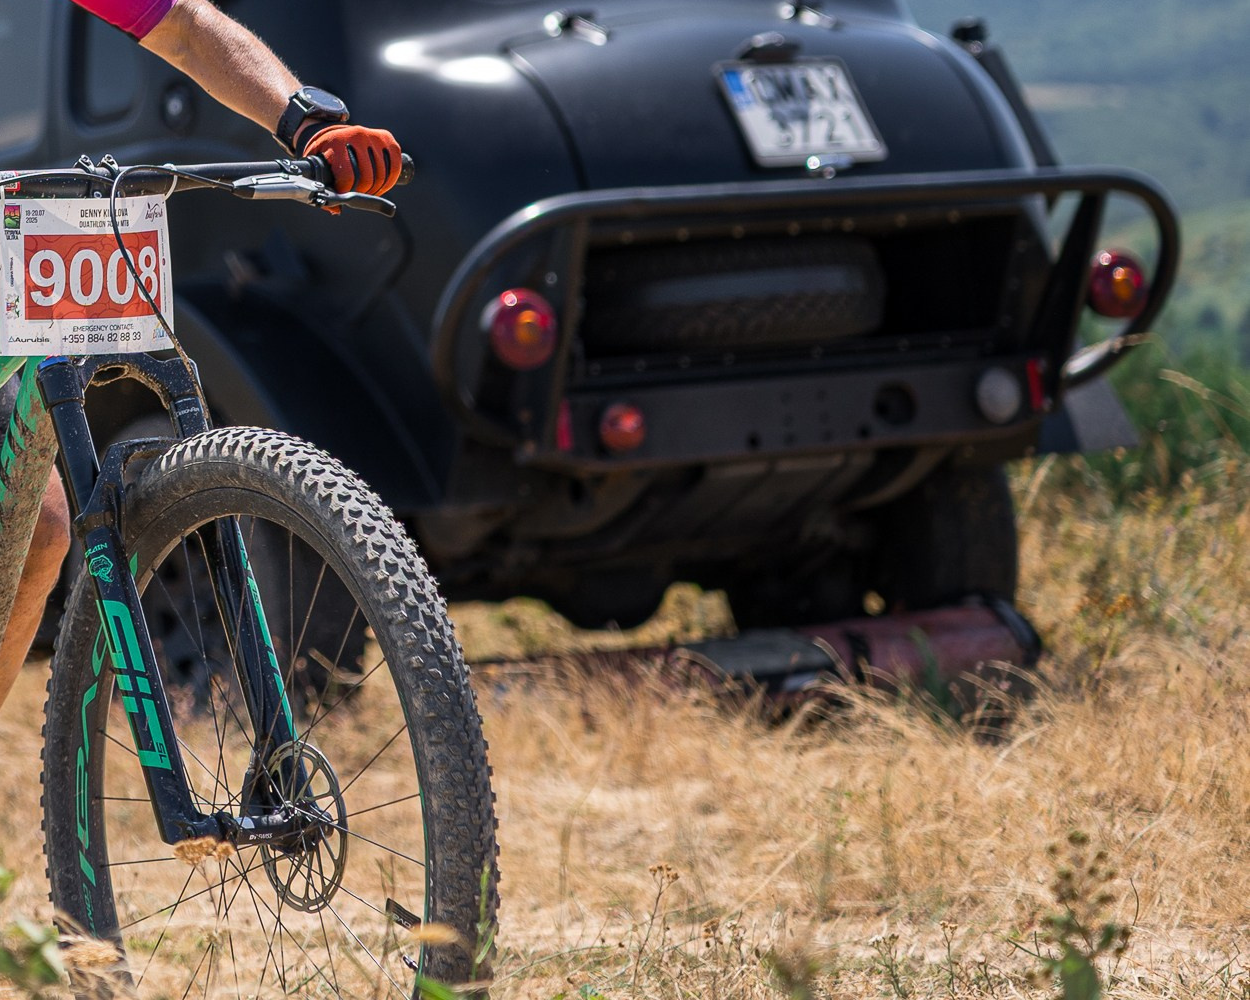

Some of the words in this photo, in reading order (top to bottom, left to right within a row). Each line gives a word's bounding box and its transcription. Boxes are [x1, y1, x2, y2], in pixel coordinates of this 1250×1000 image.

[80, 209, 102, 218] DENNY
[103, 208, 128, 218] KILOVA
[79, 220, 106, 228] DUATHLON
[28, 246, 158, 307] 9008
[72, 324, 109, 332] EMERGENCY
[109, 323, 134, 331] CONTACT
[62, 333, 85, 344] +359
[87, 332, 105, 343] 884
[107, 332, 118, 342] 82
[120, 331, 131, 341] 88
[132, 331, 142, 341] 33
